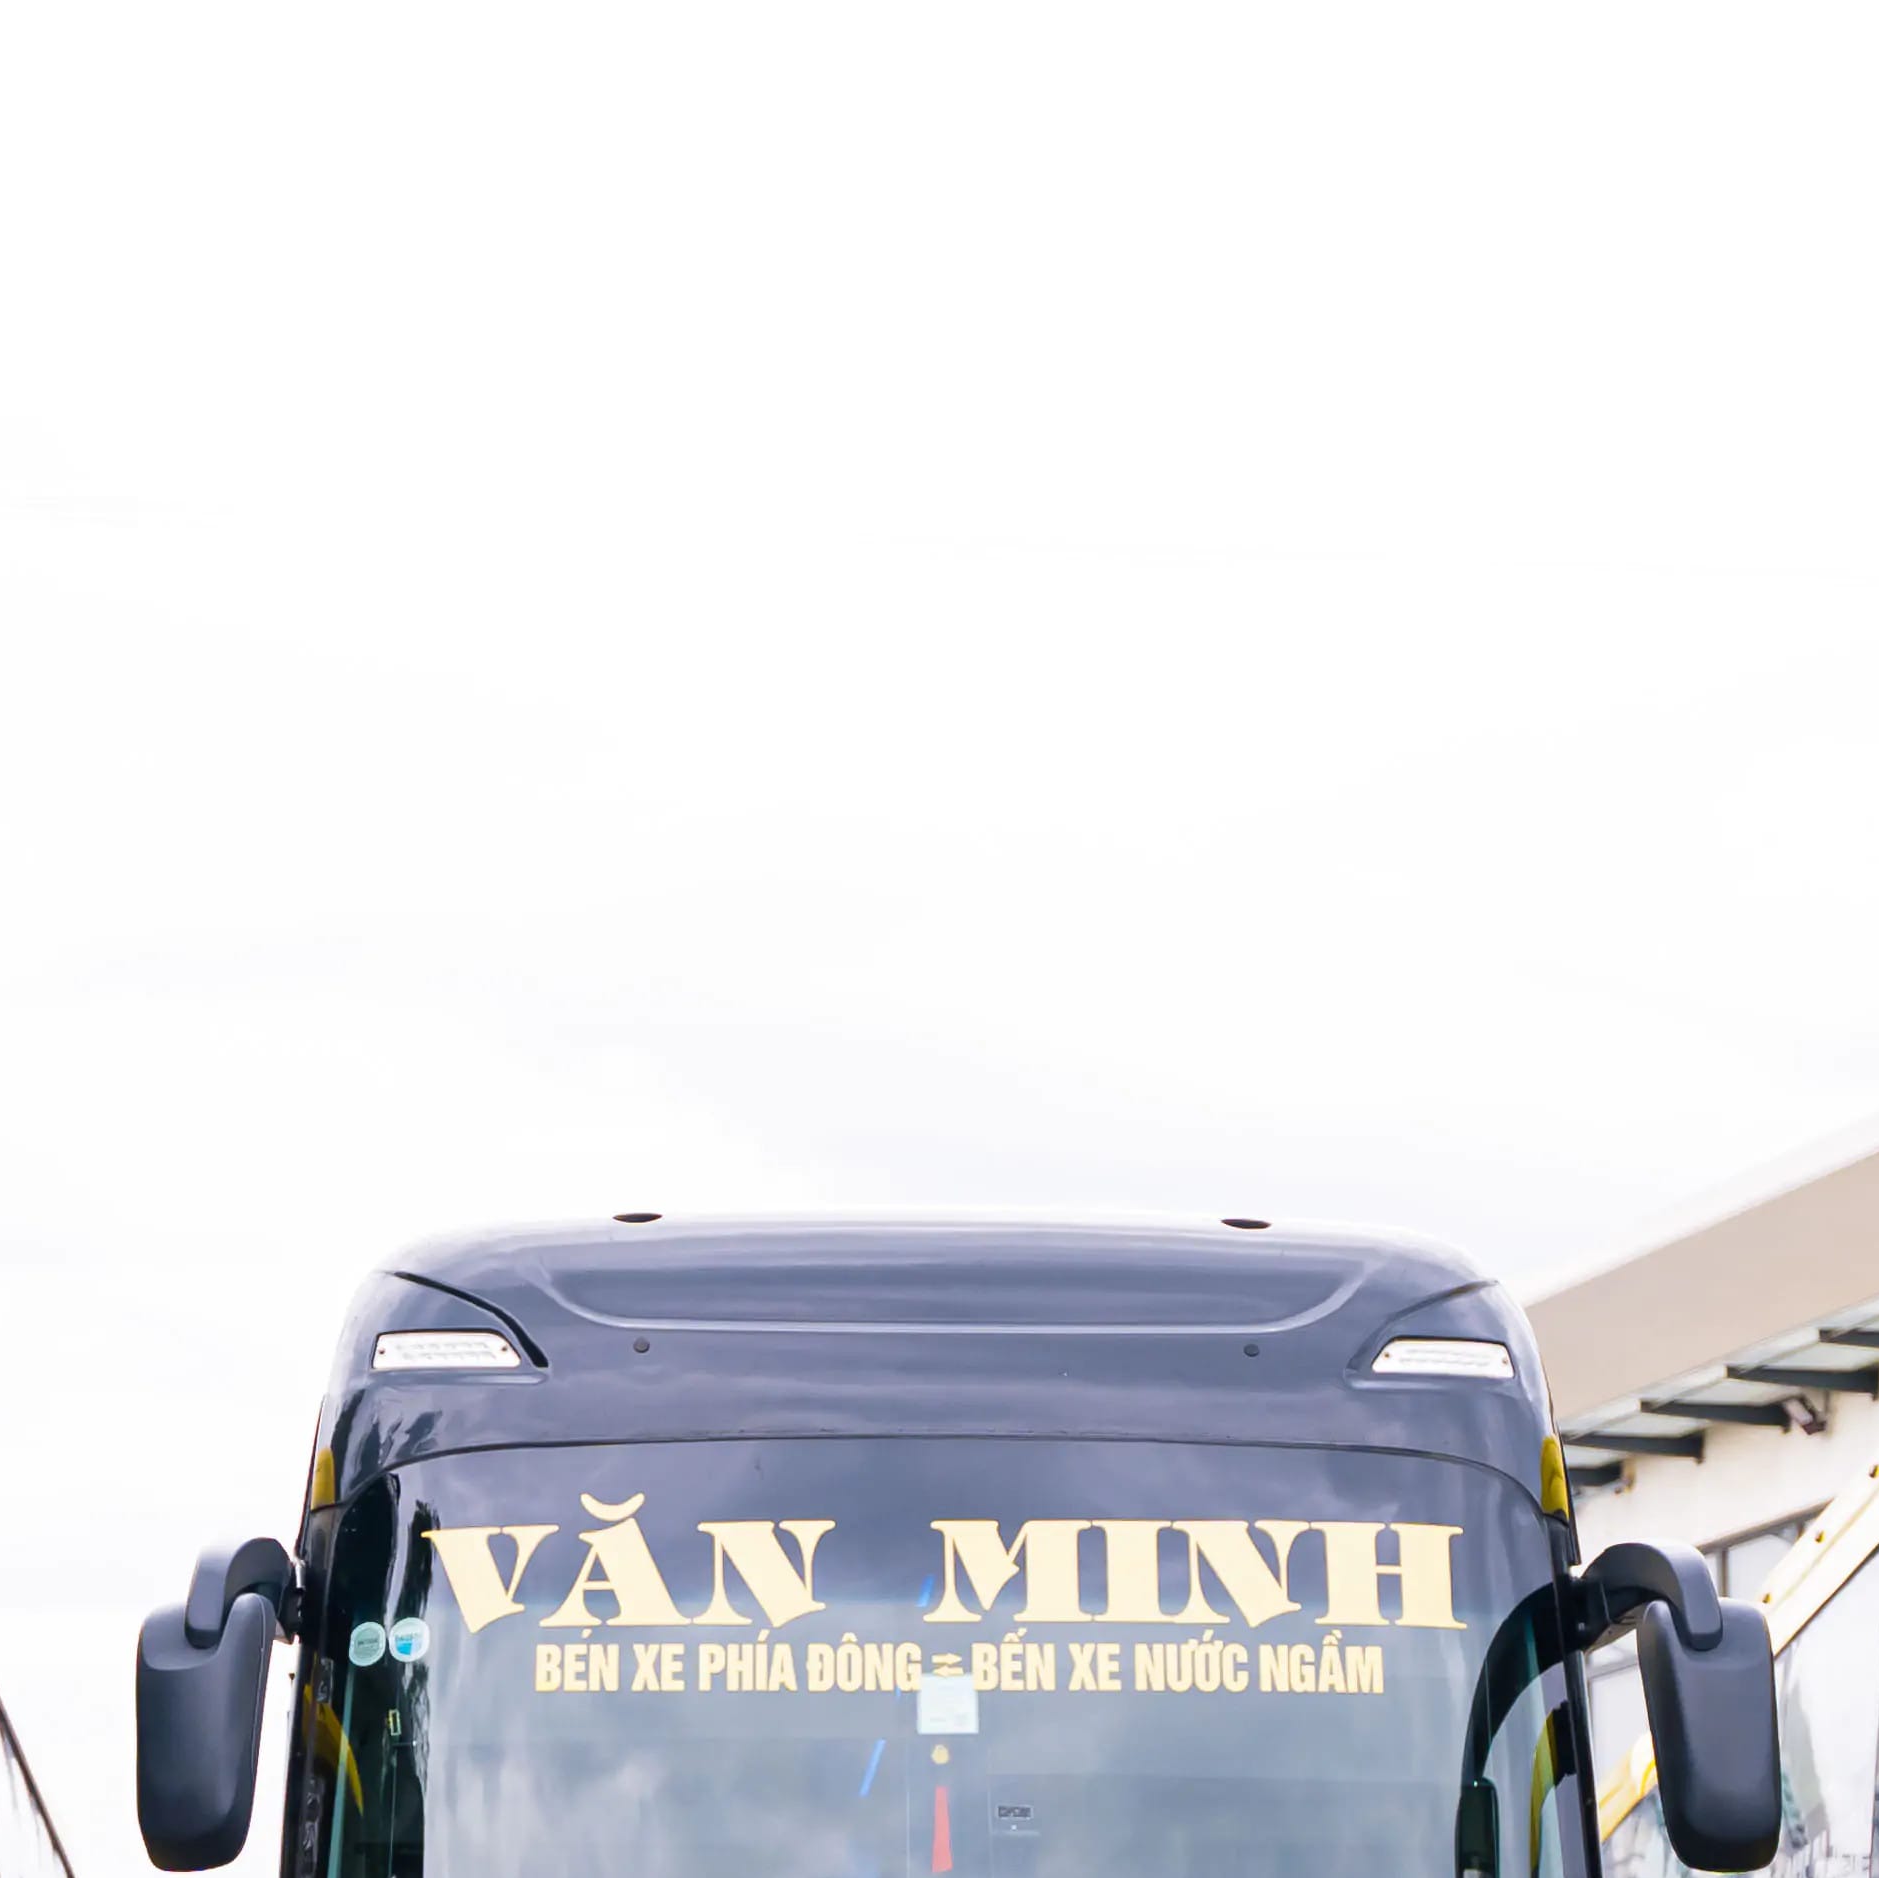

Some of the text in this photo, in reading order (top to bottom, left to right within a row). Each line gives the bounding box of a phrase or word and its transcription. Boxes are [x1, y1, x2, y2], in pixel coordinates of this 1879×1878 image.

[422, 1493, 1467, 1632] VĂN MINH
[631, 1643, 685, 1692] XE
[698, 1629, 798, 1692] PHÍA
[806, 1632, 922, 1692] ĐÔNG
[972, 1626, 1385, 1694] BẾN XE NƯỚC NGẦM
